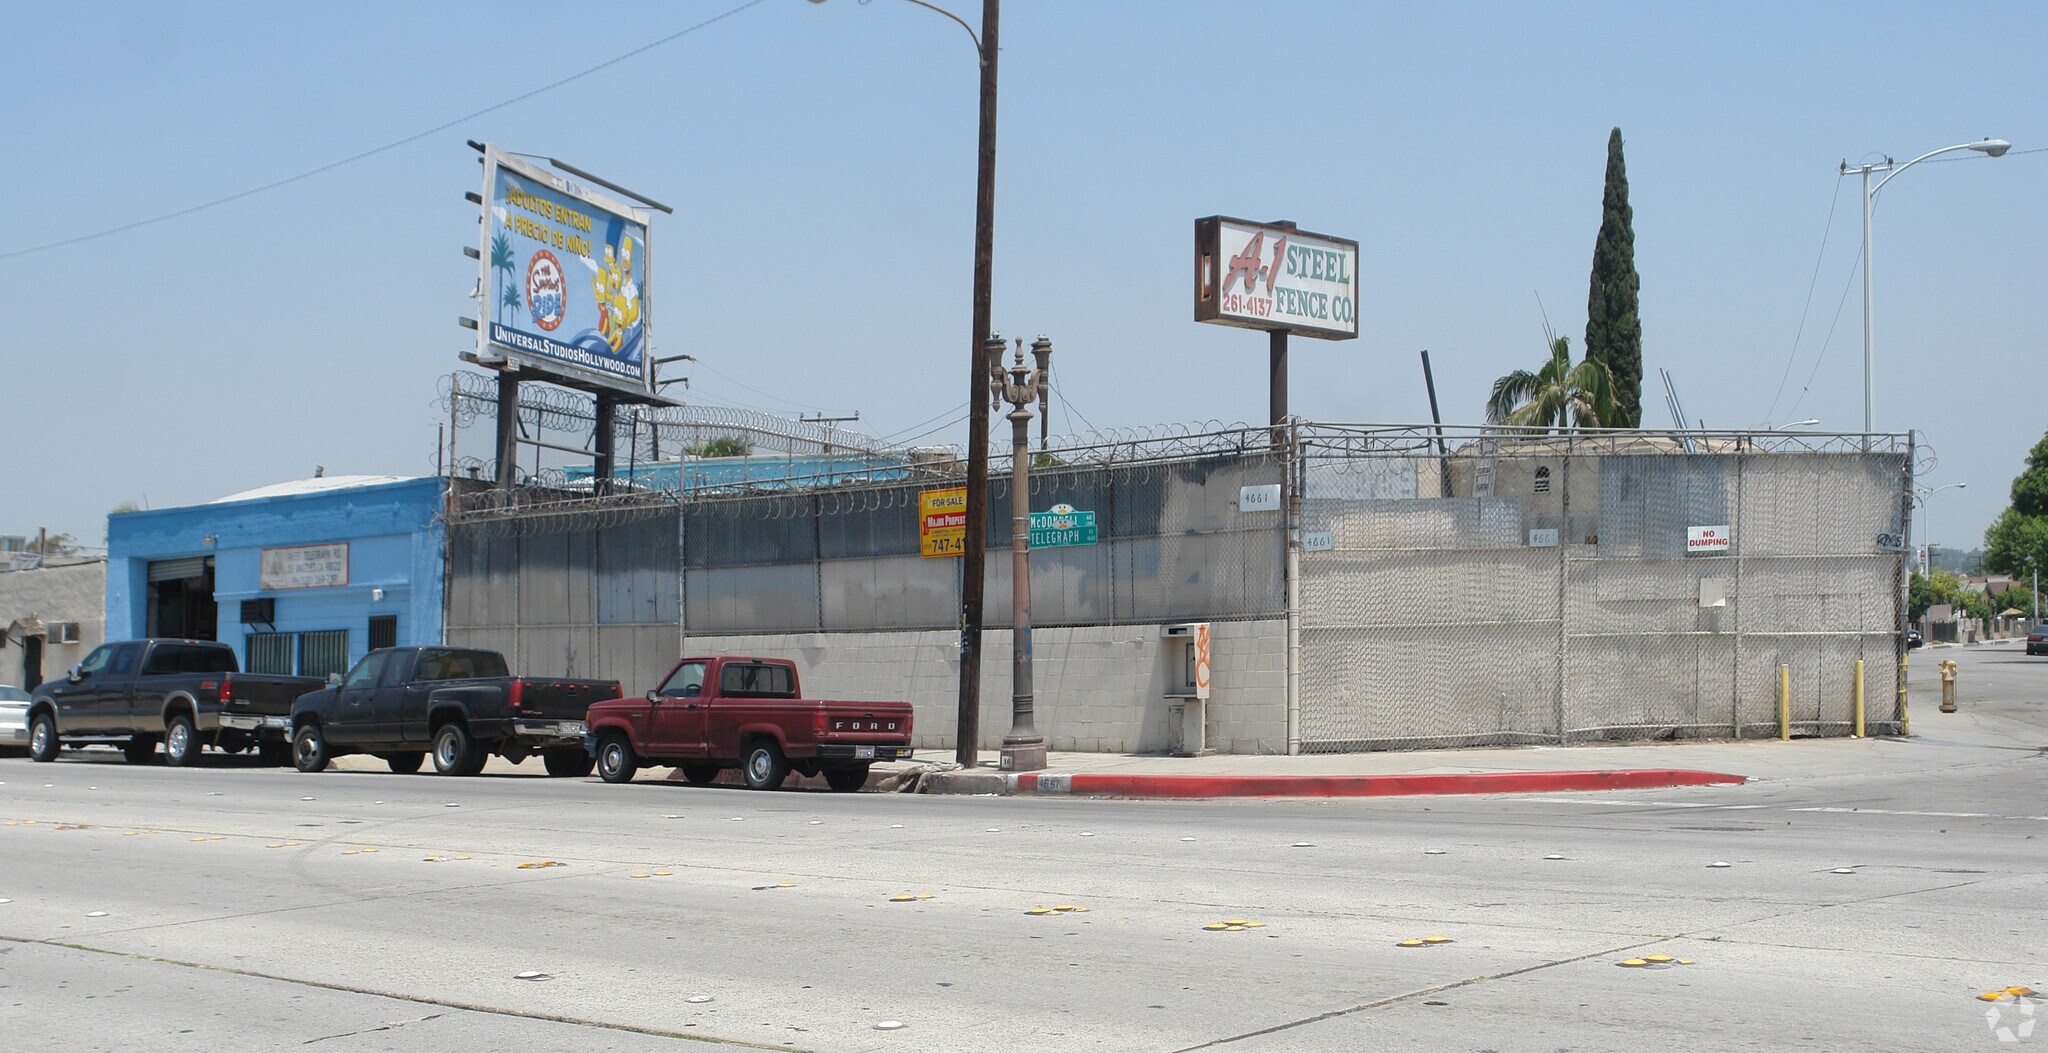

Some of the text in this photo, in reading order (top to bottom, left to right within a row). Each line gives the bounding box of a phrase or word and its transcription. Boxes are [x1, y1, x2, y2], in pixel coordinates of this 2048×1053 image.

[555, 205, 592, 233] ENTRAN
[504, 211, 592, 258] A PRECIO DE NIÑO!
[1286, 244, 1350, 285] STEEL
[532, 293, 562, 323] RIDE
[1275, 286, 1354, 323] FENCE CO.
[932, 496, 963, 507] FOR SALE
[1031, 530, 1079, 545] TELEGRAPH
[1307, 536, 1330, 547] 4661
[1690, 538, 1728, 547] DUMPING
[835, 722, 896, 730] FORD
